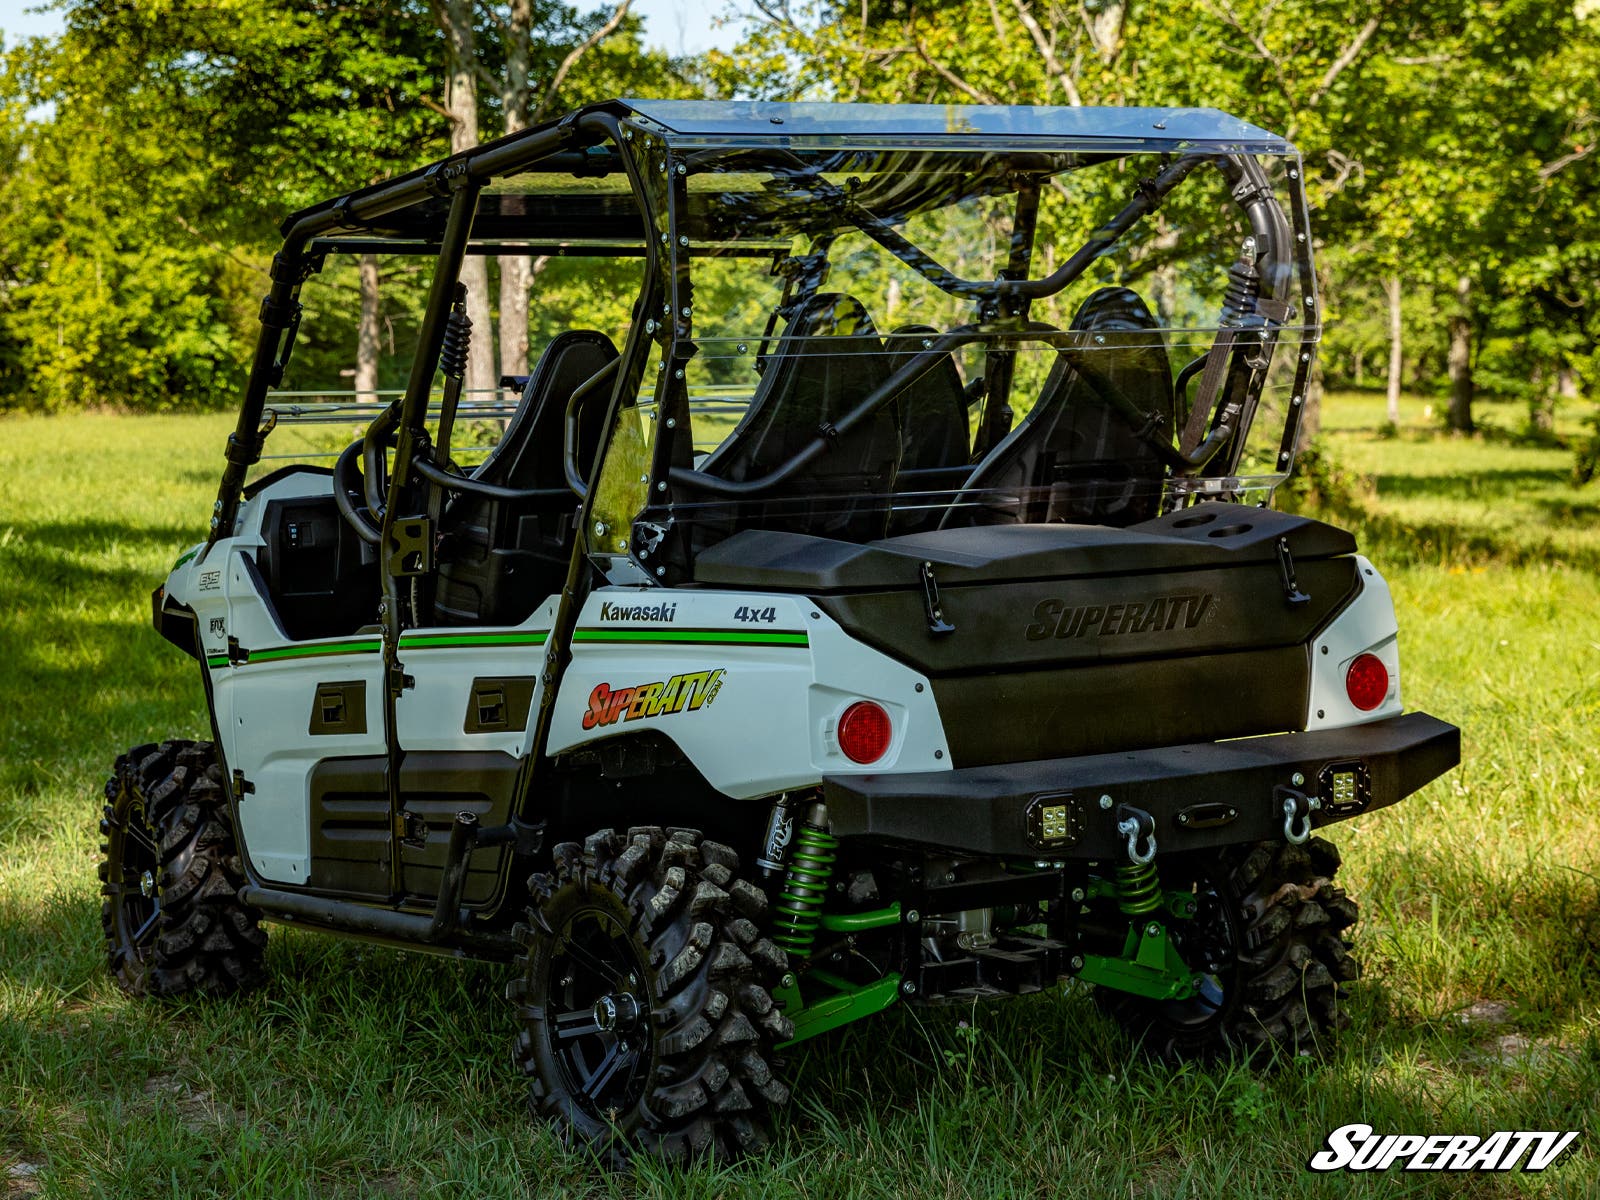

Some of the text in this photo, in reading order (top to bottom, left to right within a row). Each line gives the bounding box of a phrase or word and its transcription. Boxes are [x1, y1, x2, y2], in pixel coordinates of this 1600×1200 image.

[600, 602, 777, 623] Kawasaki 4x4
[1025, 594, 1213, 641] SUPERATV
[582, 668, 726, 731] SUPERATV
[768, 814, 790, 861] FOX
